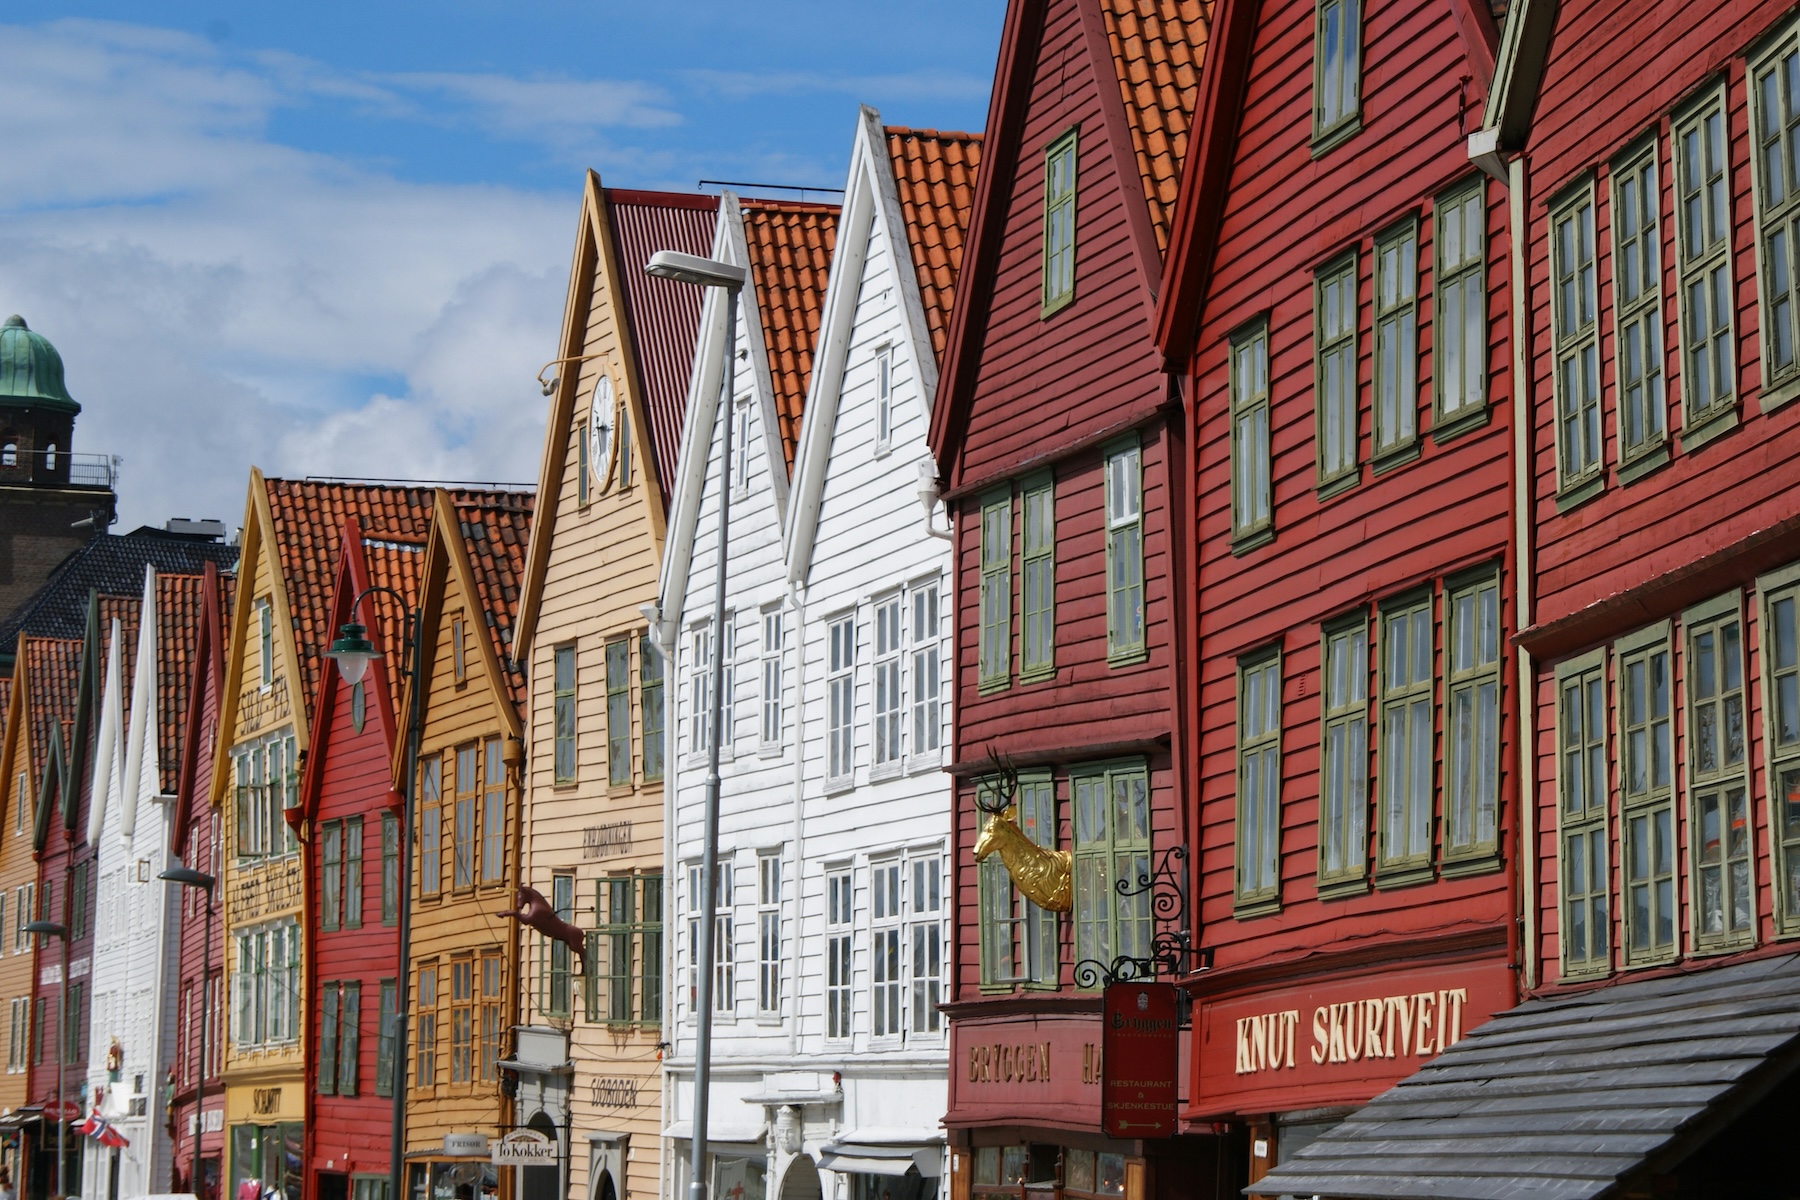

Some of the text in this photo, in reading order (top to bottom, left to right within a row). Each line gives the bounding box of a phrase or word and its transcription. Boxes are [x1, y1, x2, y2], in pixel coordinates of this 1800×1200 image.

[1111, 1012, 1172, 1032] Bryggen
[1234, 987, 1468, 1074] KNUT SKURTVEIT
[968, 1041, 1051, 1083] BRYGGEN
[1109, 1079, 1173, 1088] RESTAURANT
[591, 1077, 639, 1109] SJØBODEN
[1137, 1090, 1145, 1099] &
[1107, 1102, 1174, 1110] SKJENKESTUE
[496, 1142, 553, 1157] To Kokker
